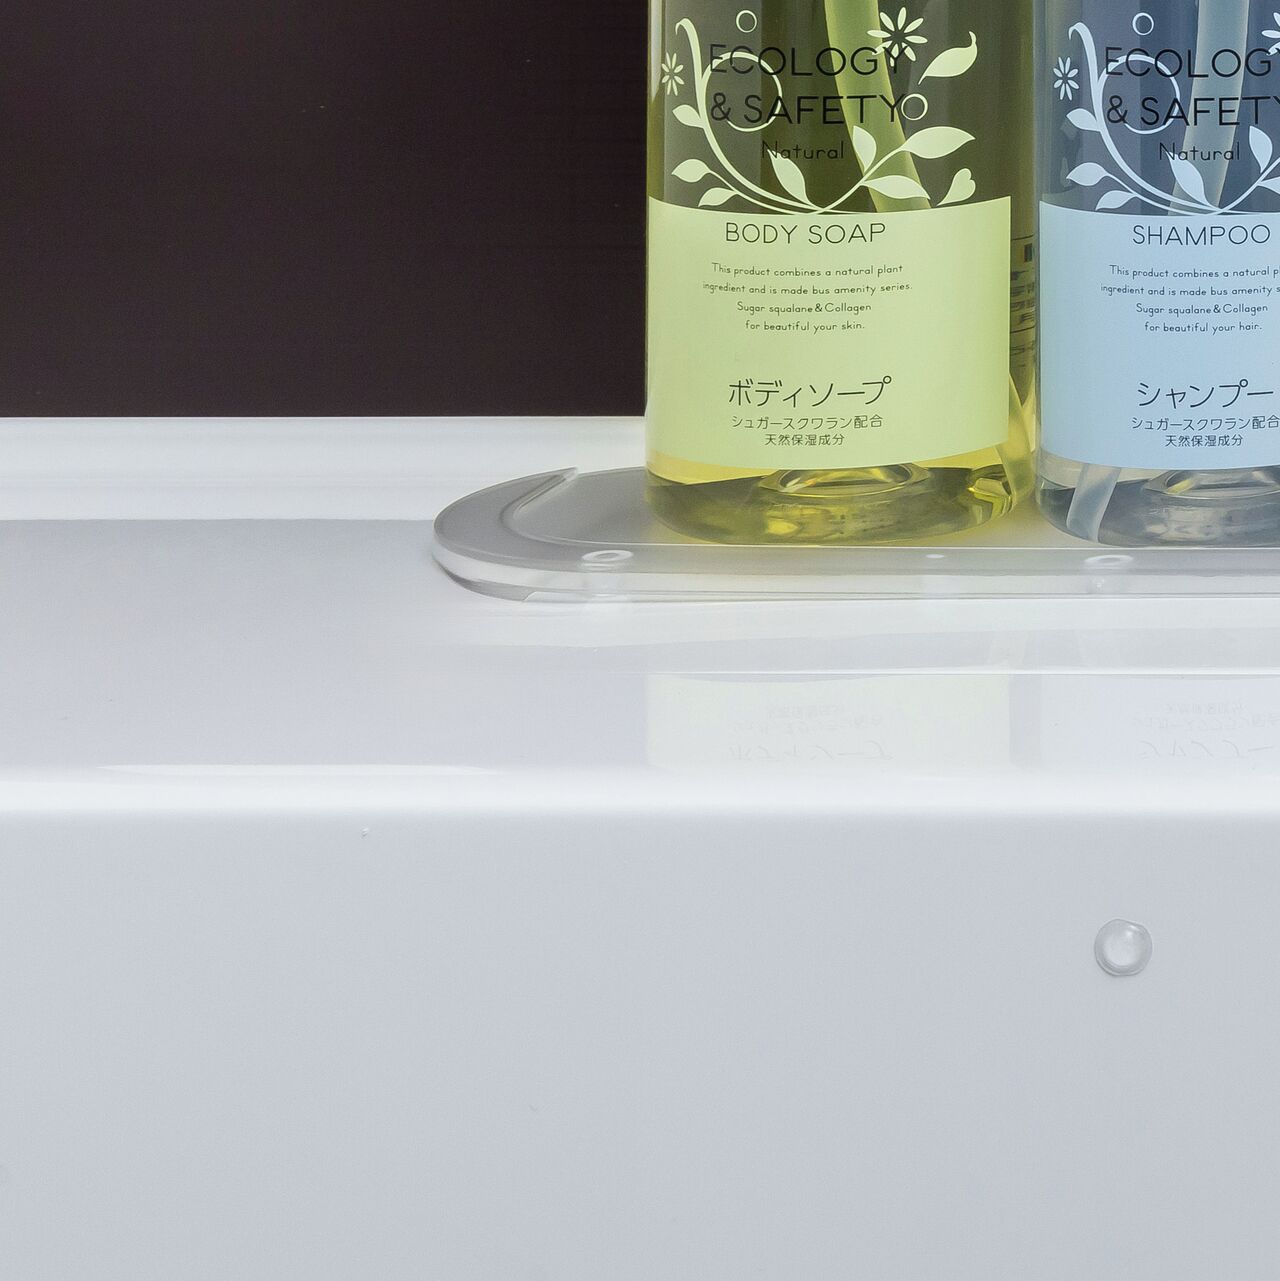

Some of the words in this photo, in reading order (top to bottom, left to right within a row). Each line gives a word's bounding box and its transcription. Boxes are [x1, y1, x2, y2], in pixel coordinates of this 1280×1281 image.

[709, 44, 911, 76] ECOLOGY
[710, 92, 731, 121] &
[744, 93, 906, 124] SAFETY
[1107, 95, 1128, 124] &
[762, 140, 845, 160] Natural
[1159, 141, 1240, 161] Natural
[726, 222, 798, 244] BODY
[808, 223, 886, 244] SOAP
[1132, 224, 1271, 246] SHAMPOO
[712, 262, 731, 274] This
[734, 266, 771, 278] product
[774, 268, 821, 277] combines
[835, 265, 873, 276] natural
[877, 265, 903, 278] plant
[1109, 265, 1129, 276] This
[1132, 269, 1169, 279] product
[1173, 270, 1219, 278] combines
[1233, 267, 1270, 277] natural
[703, 282, 746, 294] ingredient
[749, 285, 766, 294] and
[769, 286, 777, 294] is
[781, 286, 808, 295] made
[812, 285, 830, 295] bus
[834, 284, 876, 296] amenity
[880, 283, 913, 292] series.
[1101, 283, 1145, 296] ingredient
[1148, 287, 1165, 295] and
[1168, 287, 1176, 296] is
[1180, 287, 1207, 296] made
[1211, 287, 1228, 296] bus
[1232, 286, 1272, 297] amenity
[737, 301, 766, 315] Sugar
[1136, 303, 1165, 317] Sugar
[746, 320, 760, 330] for
[764, 321, 810, 331] beautiful
[813, 323, 837, 334] your
[841, 321, 865, 330] skin.
[1144, 322, 1160, 331] for
[1163, 322, 1208, 332] beautiful
[1212, 325, 1235, 335] your
[1239, 322, 1262, 331] hair.
[728, 375, 892, 408] ボディソープ
[1137, 378, 1274, 409] シャンプー
[732, 415, 883, 429] シュガースクワラン配合
[1131, 415, 1280, 431] シュガースクワラン配合
[764, 433, 845, 446] 天然保湿成分
[1165, 434, 1243, 447] 天然保湿成分
